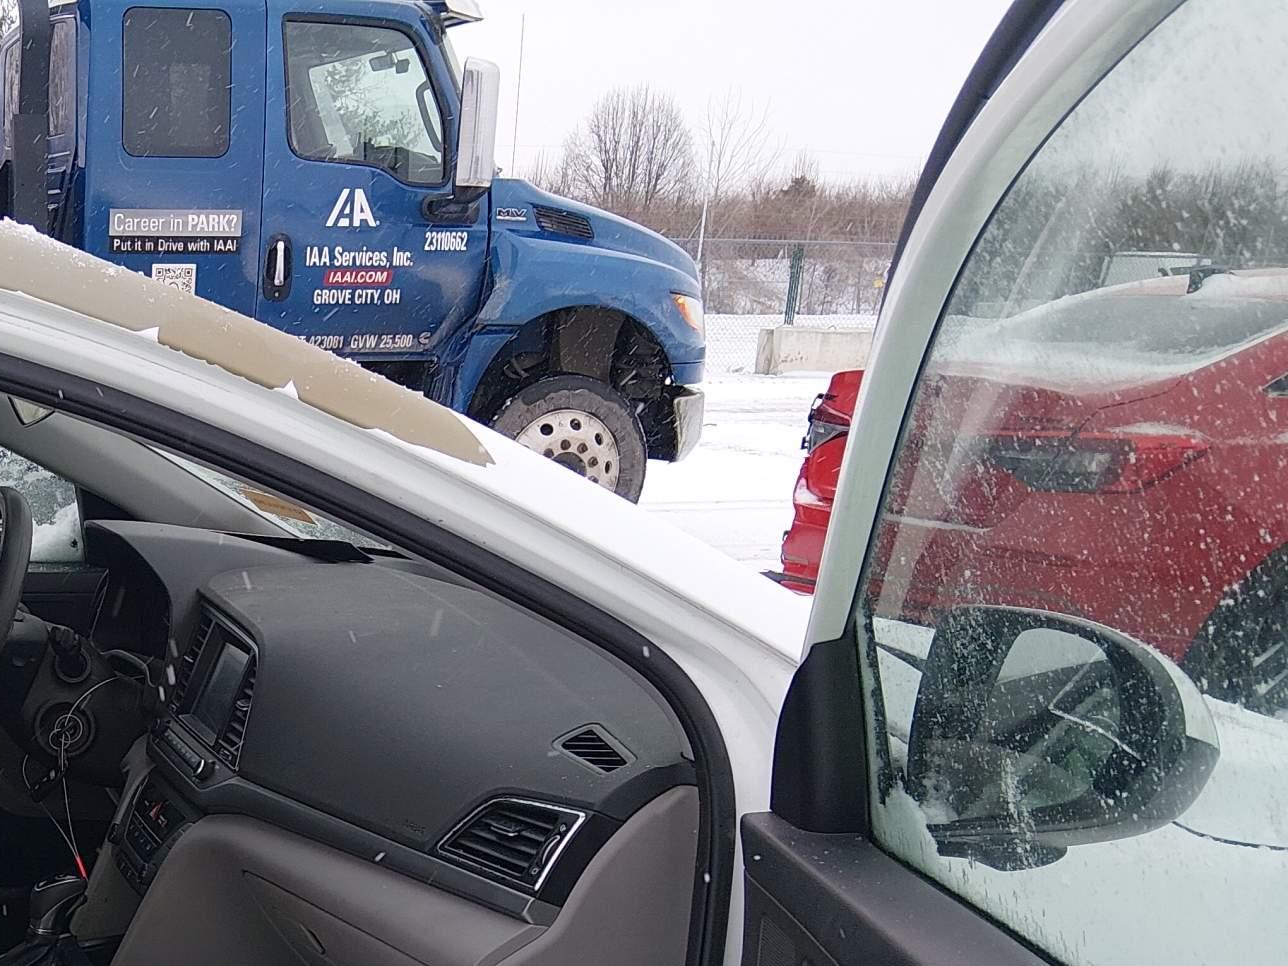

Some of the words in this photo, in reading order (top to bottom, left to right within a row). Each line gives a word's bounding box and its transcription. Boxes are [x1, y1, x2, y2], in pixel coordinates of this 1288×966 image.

[114, 213, 166, 231] Career
[170, 214, 183, 231] in
[188, 214, 237, 232] PARK?
[113, 239, 132, 251] Put
[134, 239, 142, 251] it
[145, 239, 154, 251] in
[158, 239, 184, 251] Drive
[188, 239, 210, 252] with
[214, 239, 237, 252] IAAI
[424, 231, 468, 251] 23110662
[305, 247, 330, 266] IAA
[334, 246, 390, 268] Services,
[393, 247, 413, 267] Inc.
[328, 271, 388, 283] IAAI.COM
[313, 289, 353, 305] GROVE
[355, 289, 381, 306] CITY,
[384, 289, 401, 305] OH
[350, 335, 378, 348] GVW
[380, 335, 413, 349] 25,500
